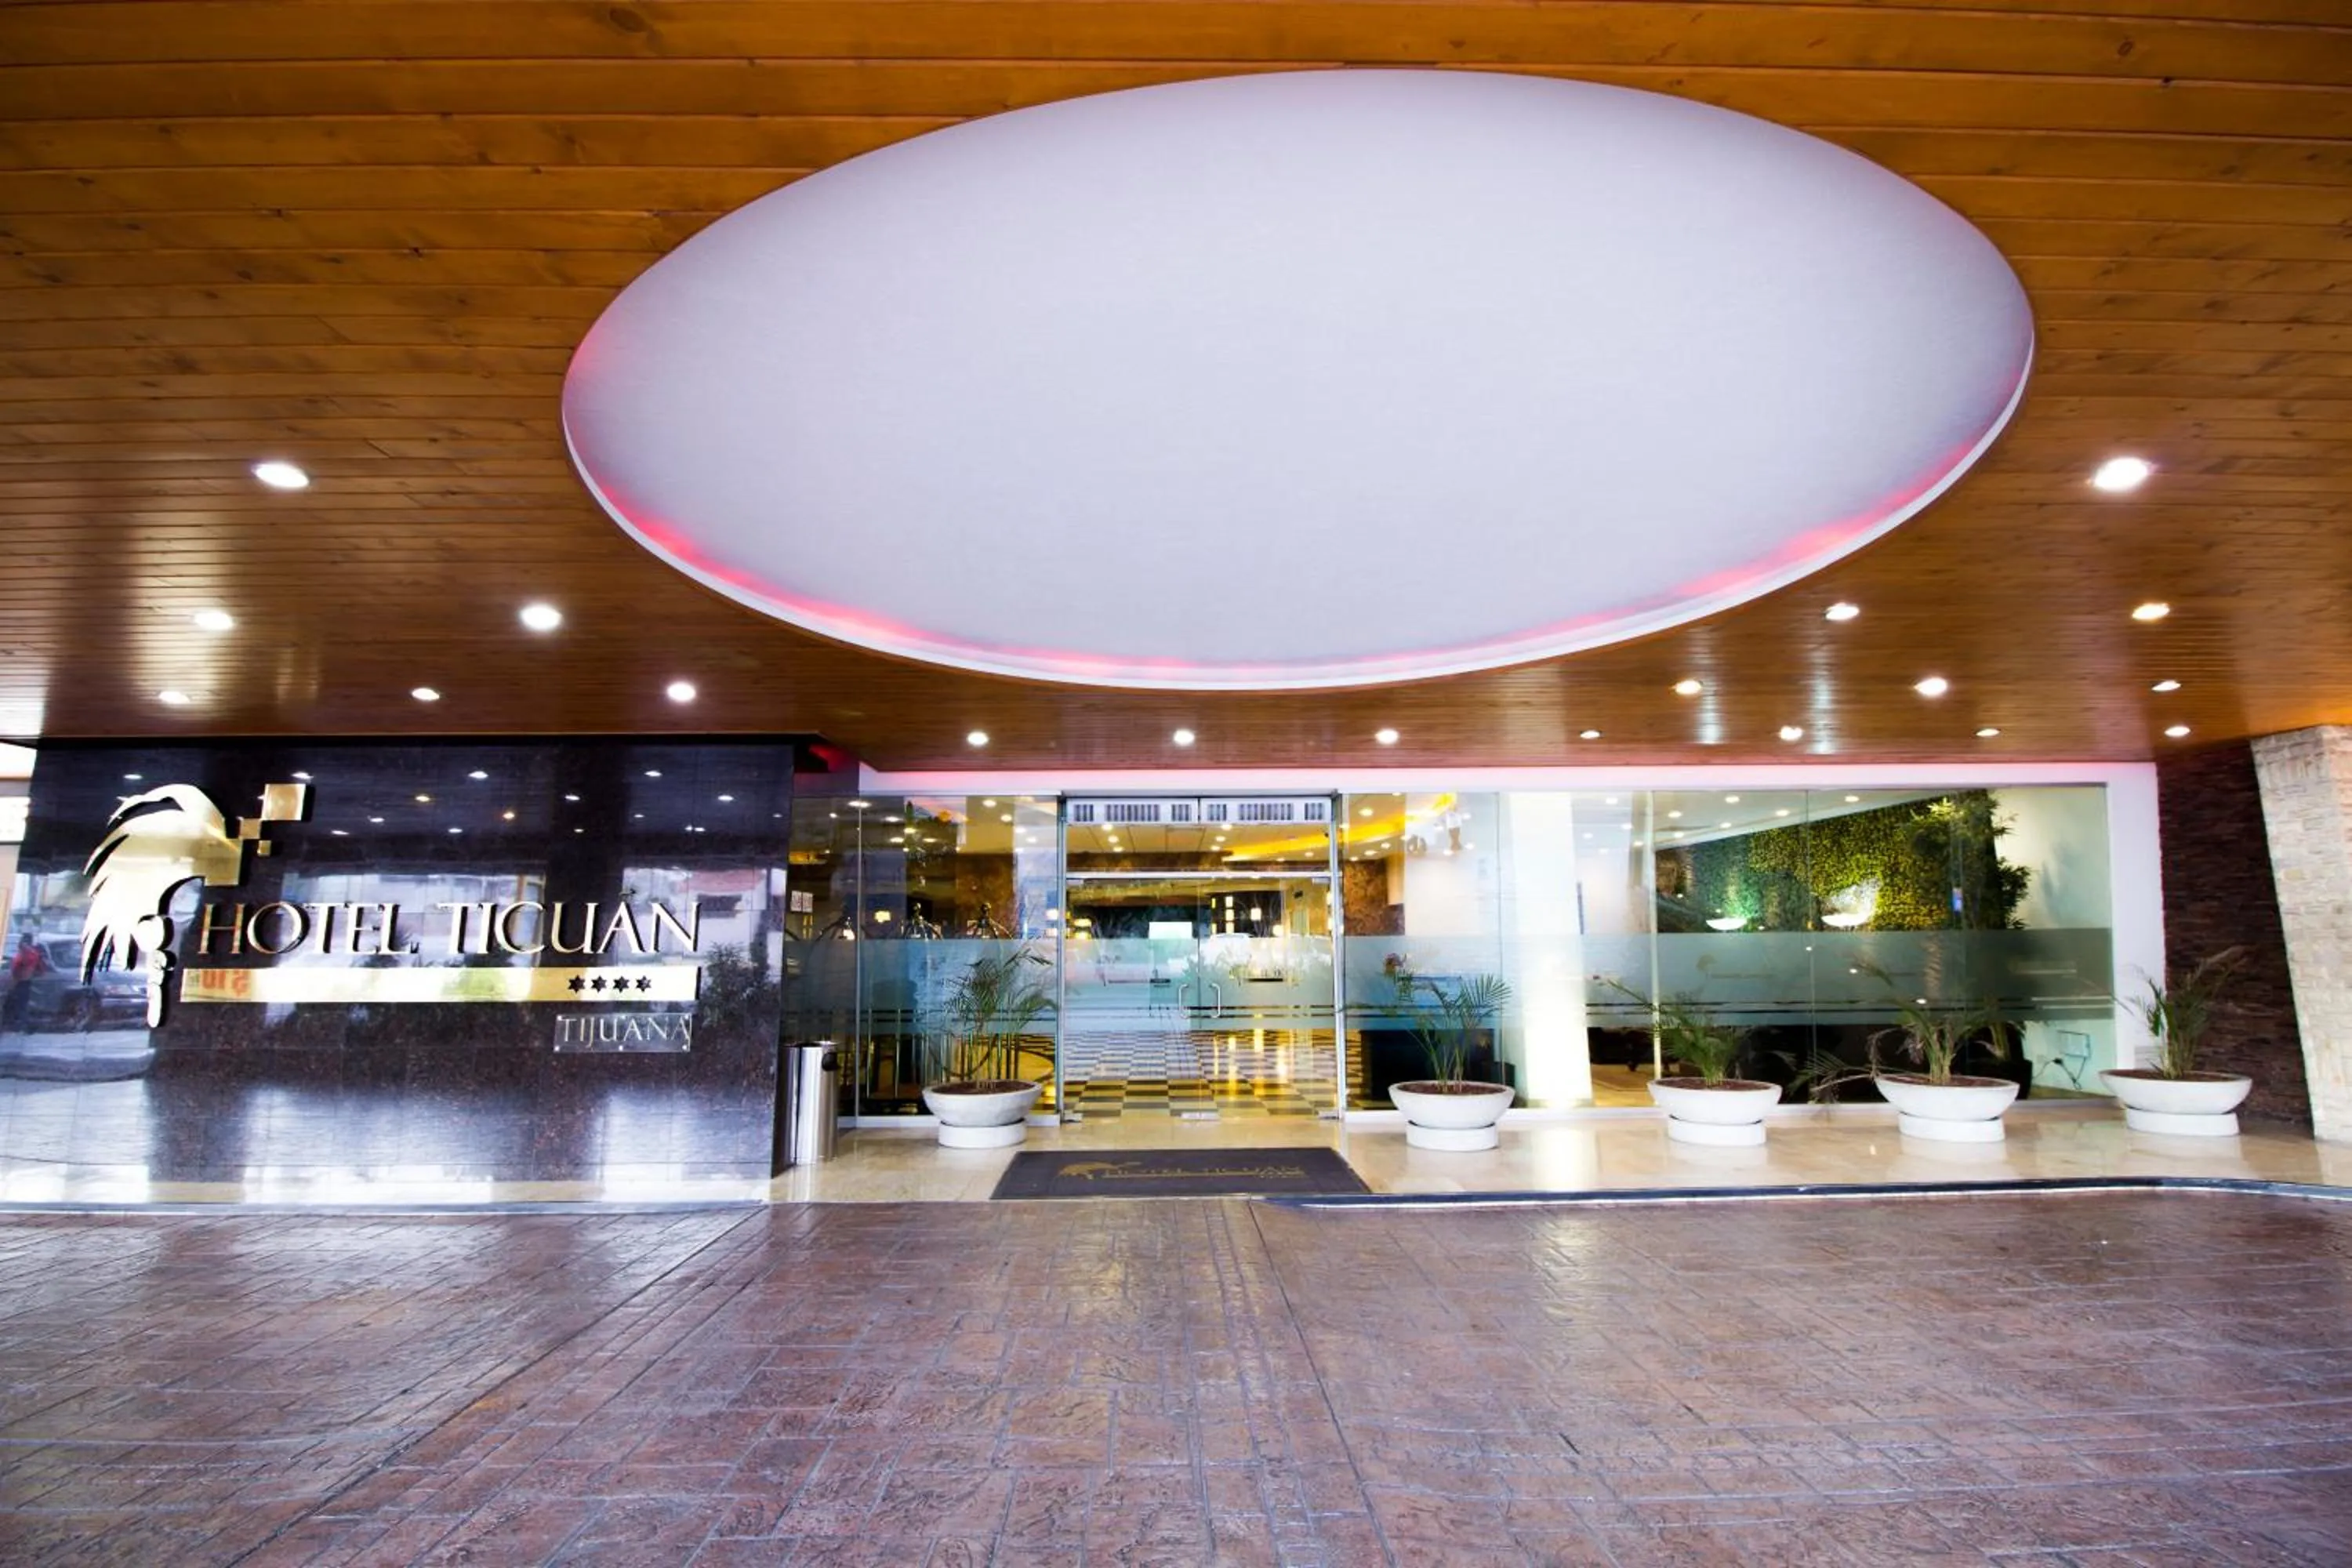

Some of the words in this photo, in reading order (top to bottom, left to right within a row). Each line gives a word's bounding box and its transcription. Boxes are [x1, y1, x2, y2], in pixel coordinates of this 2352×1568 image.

[198, 901, 412, 954] HOTEL
[437, 901, 700, 954] TICUAN
[560, 1016, 690, 1048] TIJUANA
